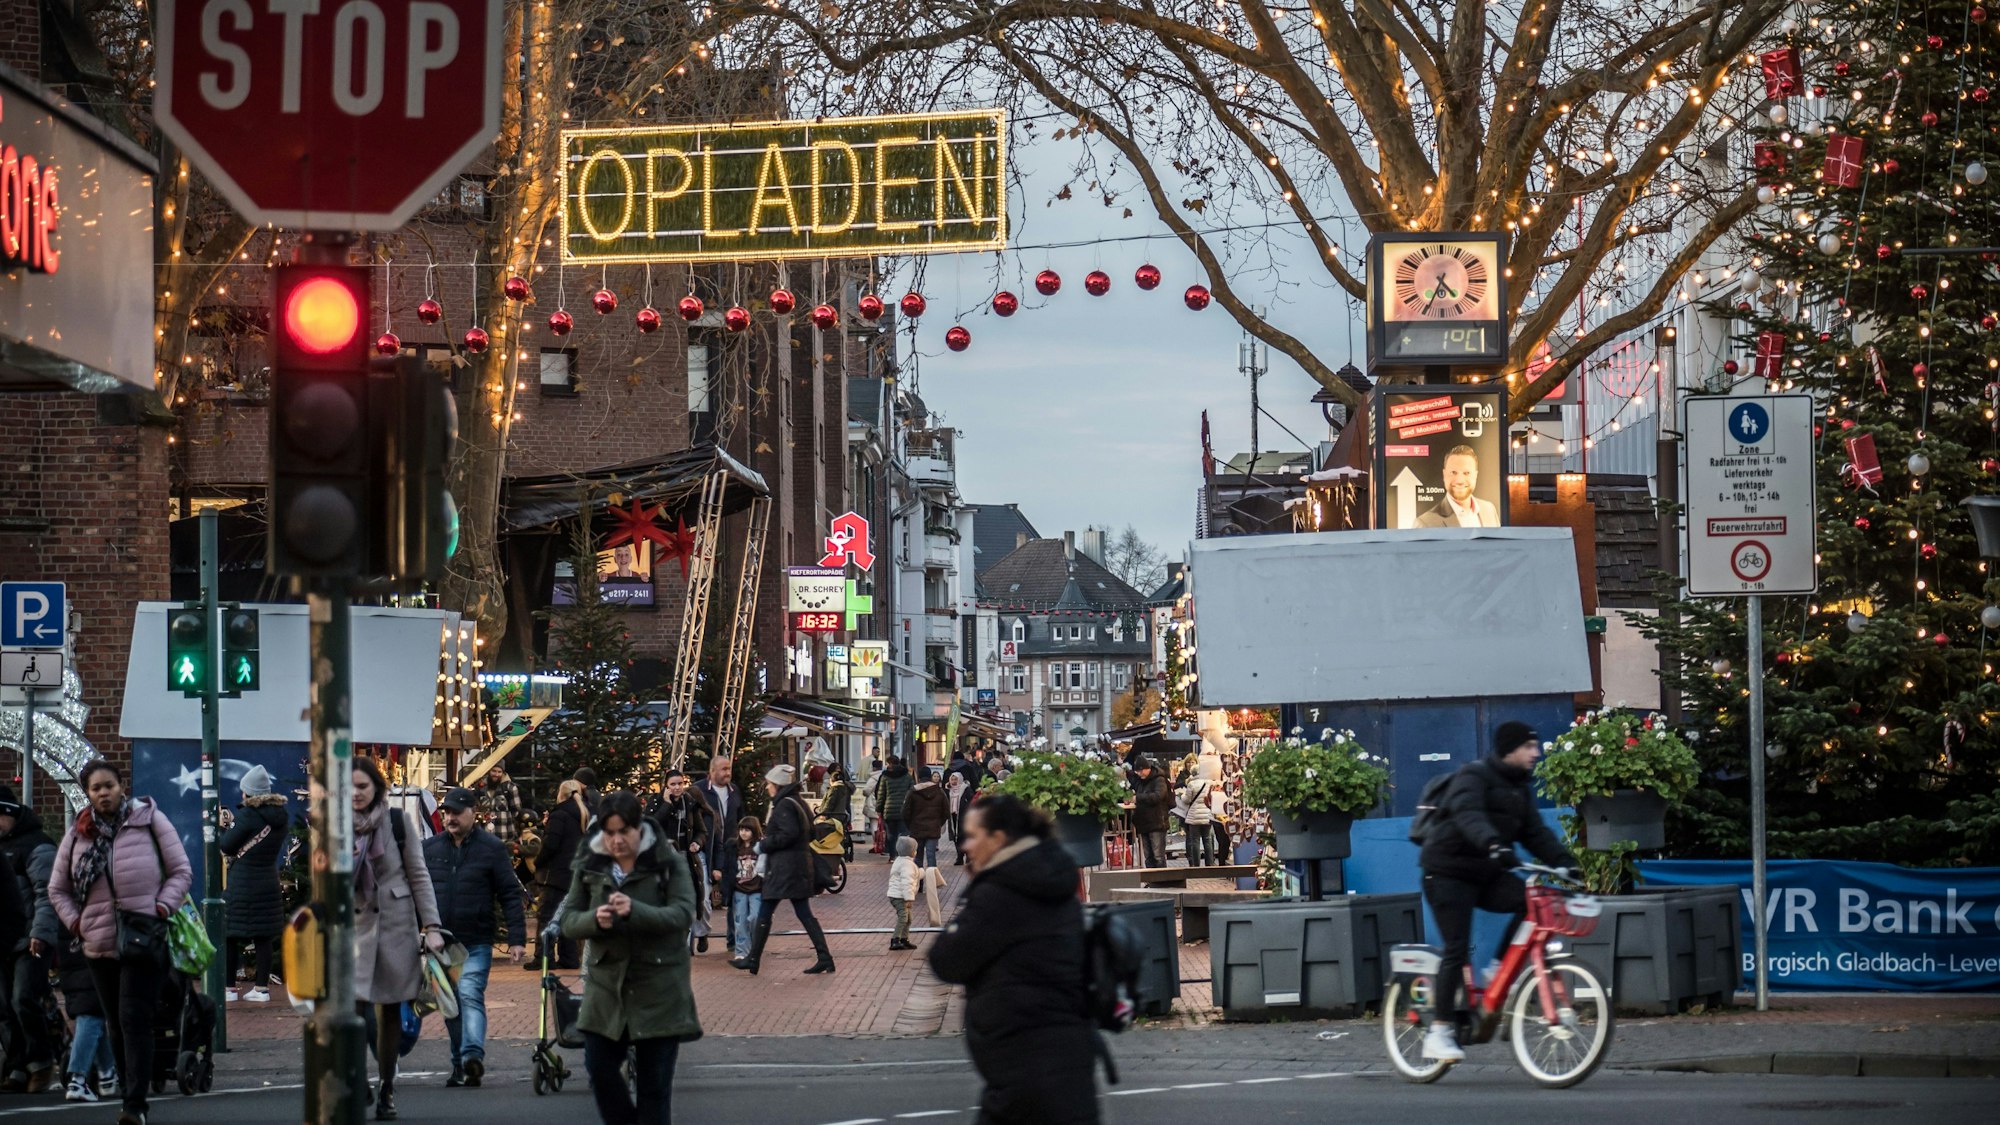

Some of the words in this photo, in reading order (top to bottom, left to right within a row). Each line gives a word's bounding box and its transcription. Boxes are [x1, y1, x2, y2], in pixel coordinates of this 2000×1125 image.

[200, 0, 460, 118] STOP
[578, 131, 984, 241] OPLADEN
[0, 142, 60, 275] one
[1416, 423, 1449, 434] Mobilfunk
[1739, 445, 1760, 454] Zone
[1710, 457, 1745, 467] Radfahrer
[1747, 456, 1760, 466] frei
[1724, 468, 1773, 478] Lieferverkehr
[1733, 481, 1766, 491] werktags
[1719, 493, 1724, 502] 6
[1767, 492, 1780, 501] 14h
[1744, 504, 1758, 513] frei
[1711, 521, 1783, 532] Feuerwehrzufahrt
[634, 590, 649, 598] 2411
[798, 585, 811, 593] DR.
[813, 585, 844, 593] SCHREY
[16, 590, 50, 639] P
[802, 614, 838, 629] 16:32
[1309, 708, 1320, 723] 7
[1740, 887, 1819, 933] VR
[1839, 887, 1977, 934] Bank
[1742, 952, 1830, 976] Brgisch
[1836, 951, 2000, 973] Gladbach-Leve
